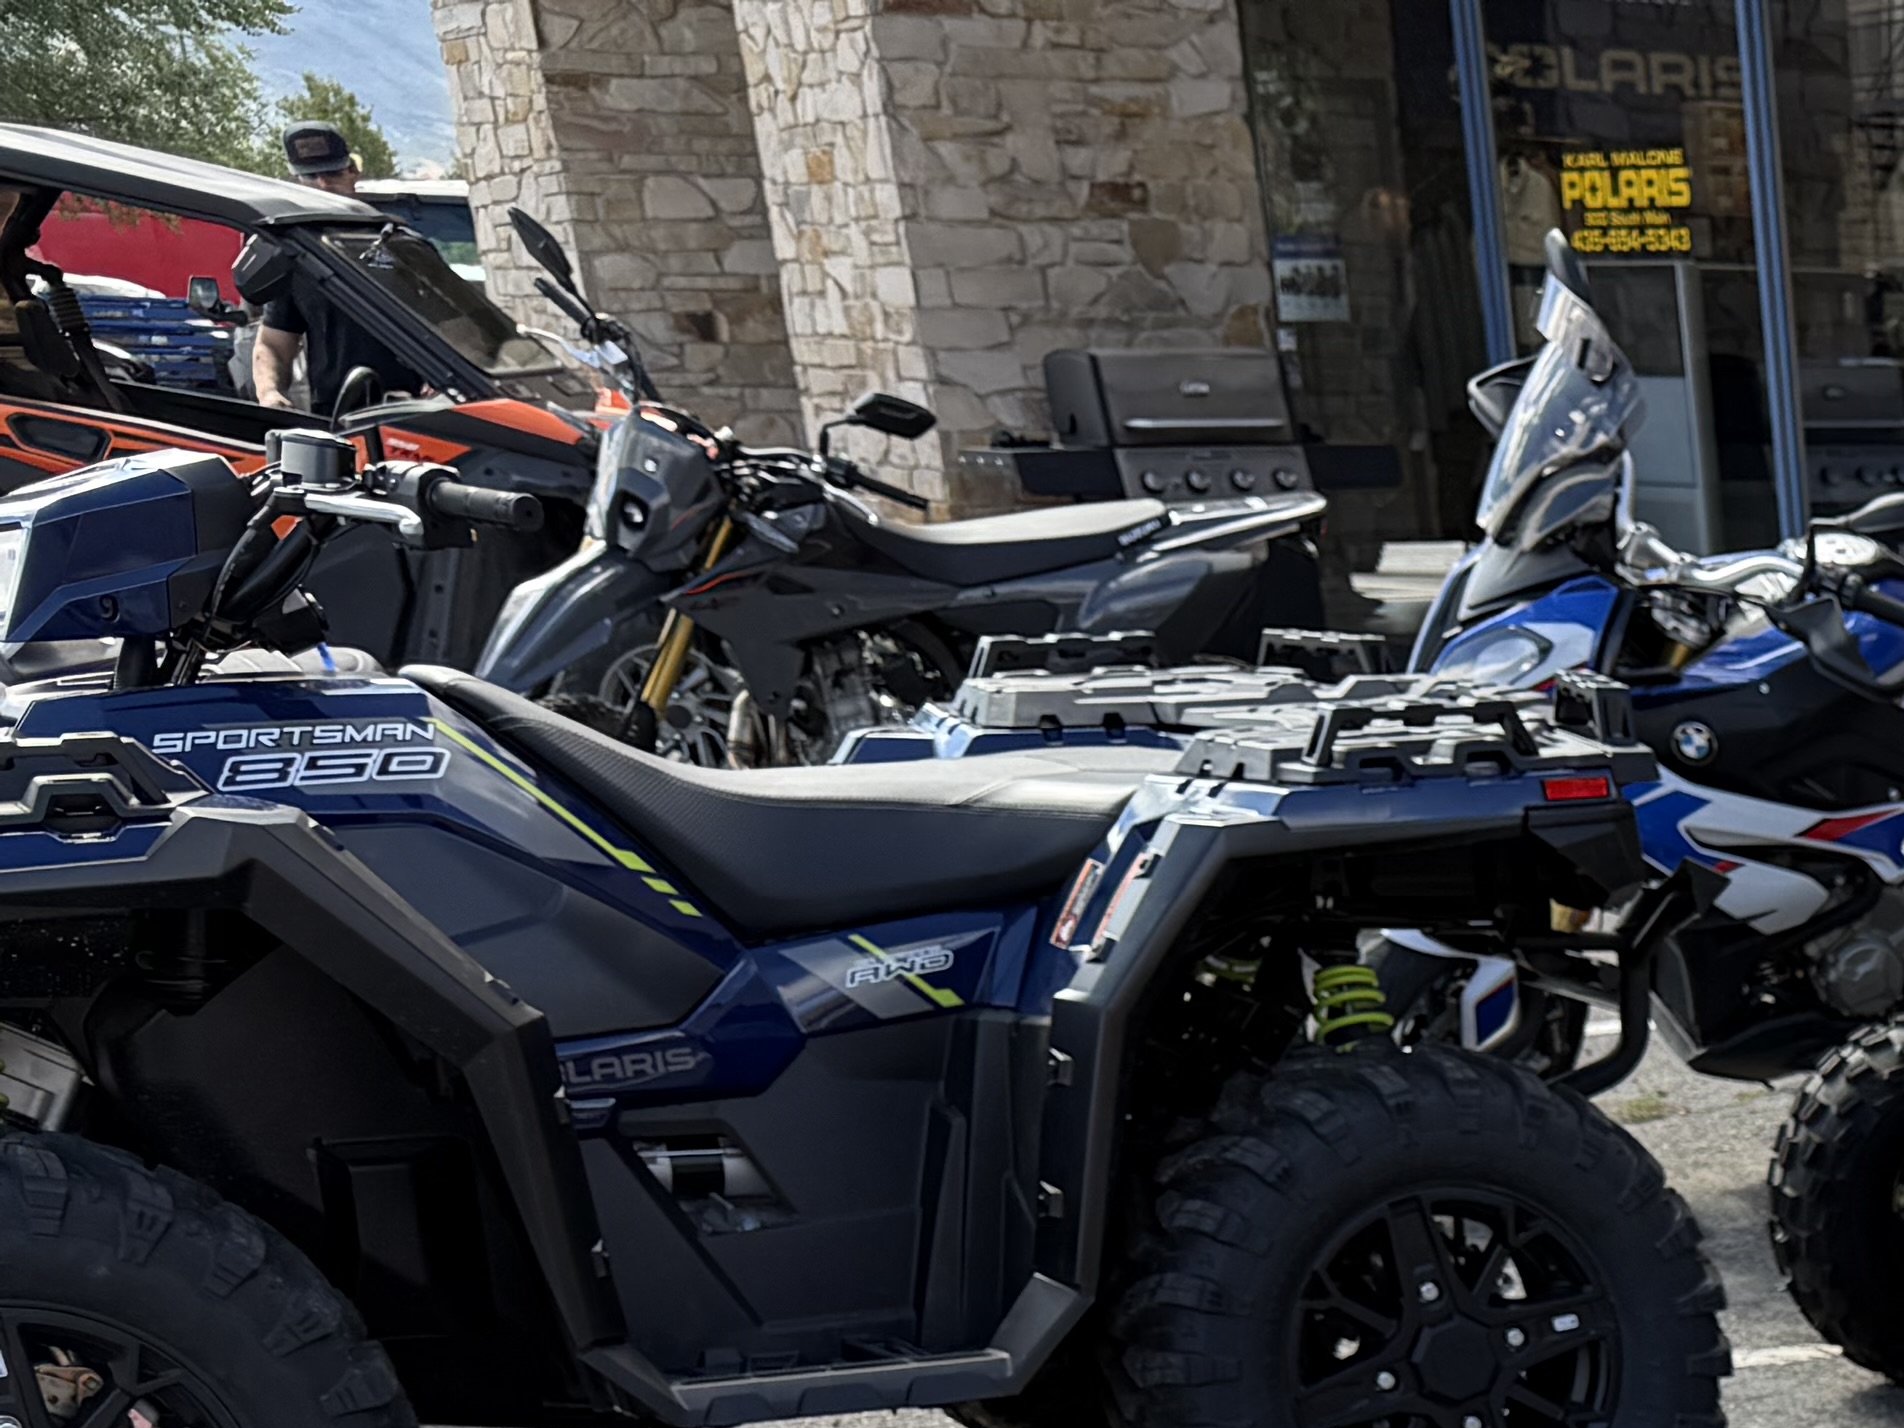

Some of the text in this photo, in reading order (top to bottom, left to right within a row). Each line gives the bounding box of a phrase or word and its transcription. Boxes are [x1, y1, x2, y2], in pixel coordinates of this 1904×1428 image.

[1490, 43, 1743, 98] OLARIS
[1559, 166, 1692, 210] POLARIS
[152, 723, 435, 754] SPORTSMAN
[217, 747, 450, 792] 850
[845, 949, 955, 988] AWD
[559, 1047, 696, 1085] LARIS
